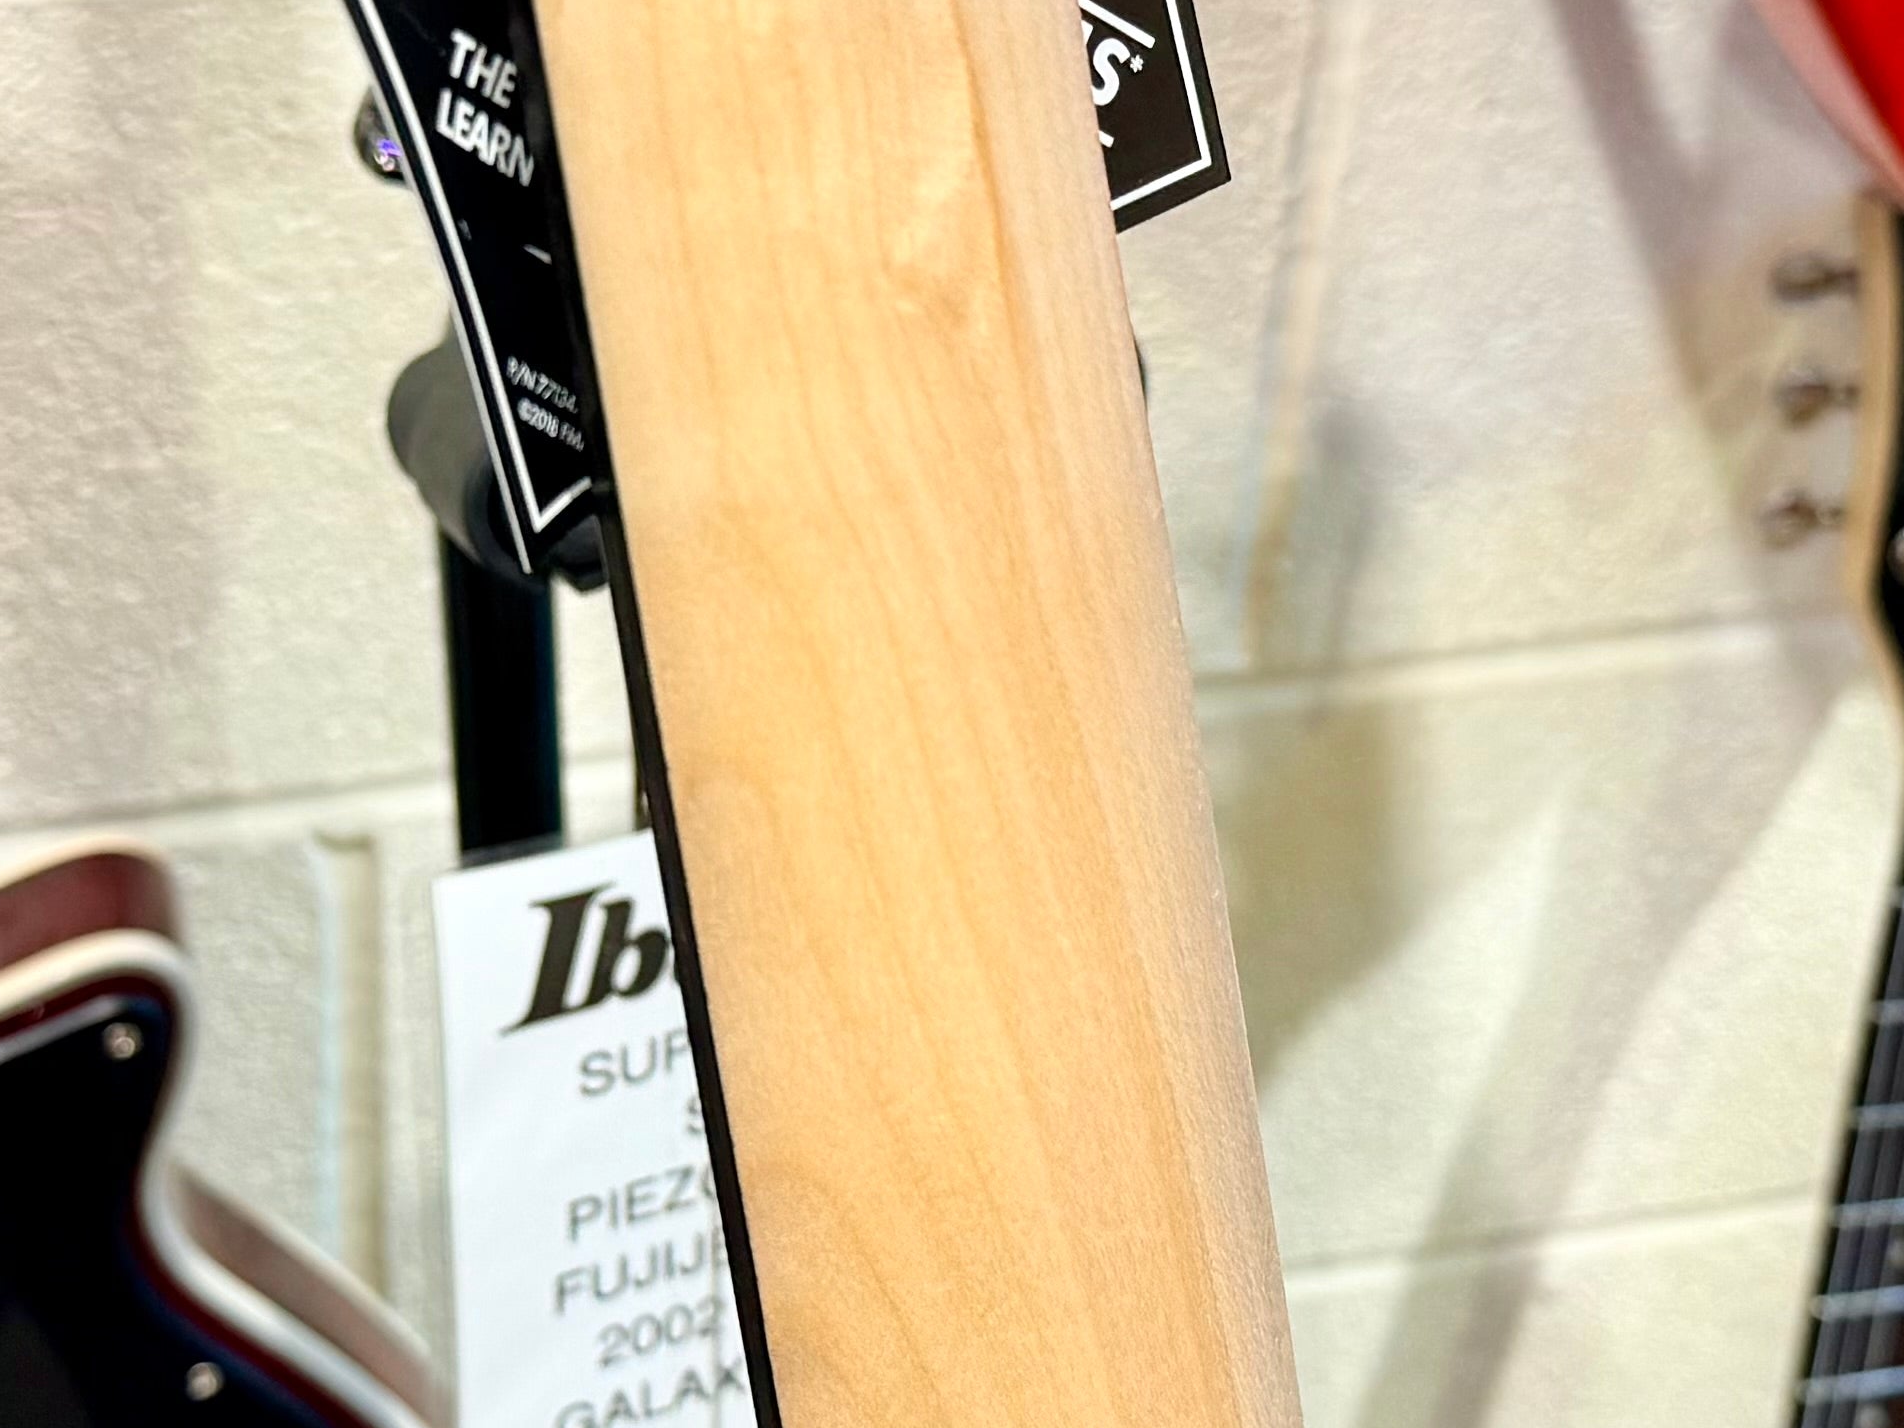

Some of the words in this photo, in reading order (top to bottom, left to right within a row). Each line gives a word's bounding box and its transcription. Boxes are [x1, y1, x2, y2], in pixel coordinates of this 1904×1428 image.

[450, 28, 518, 108] THE
[436, 87, 535, 188] LEARN
[498, 878, 675, 1036] Ib
[564, 1164, 714, 1244] PIEZ
[598, 1293, 727, 1369] 2002
